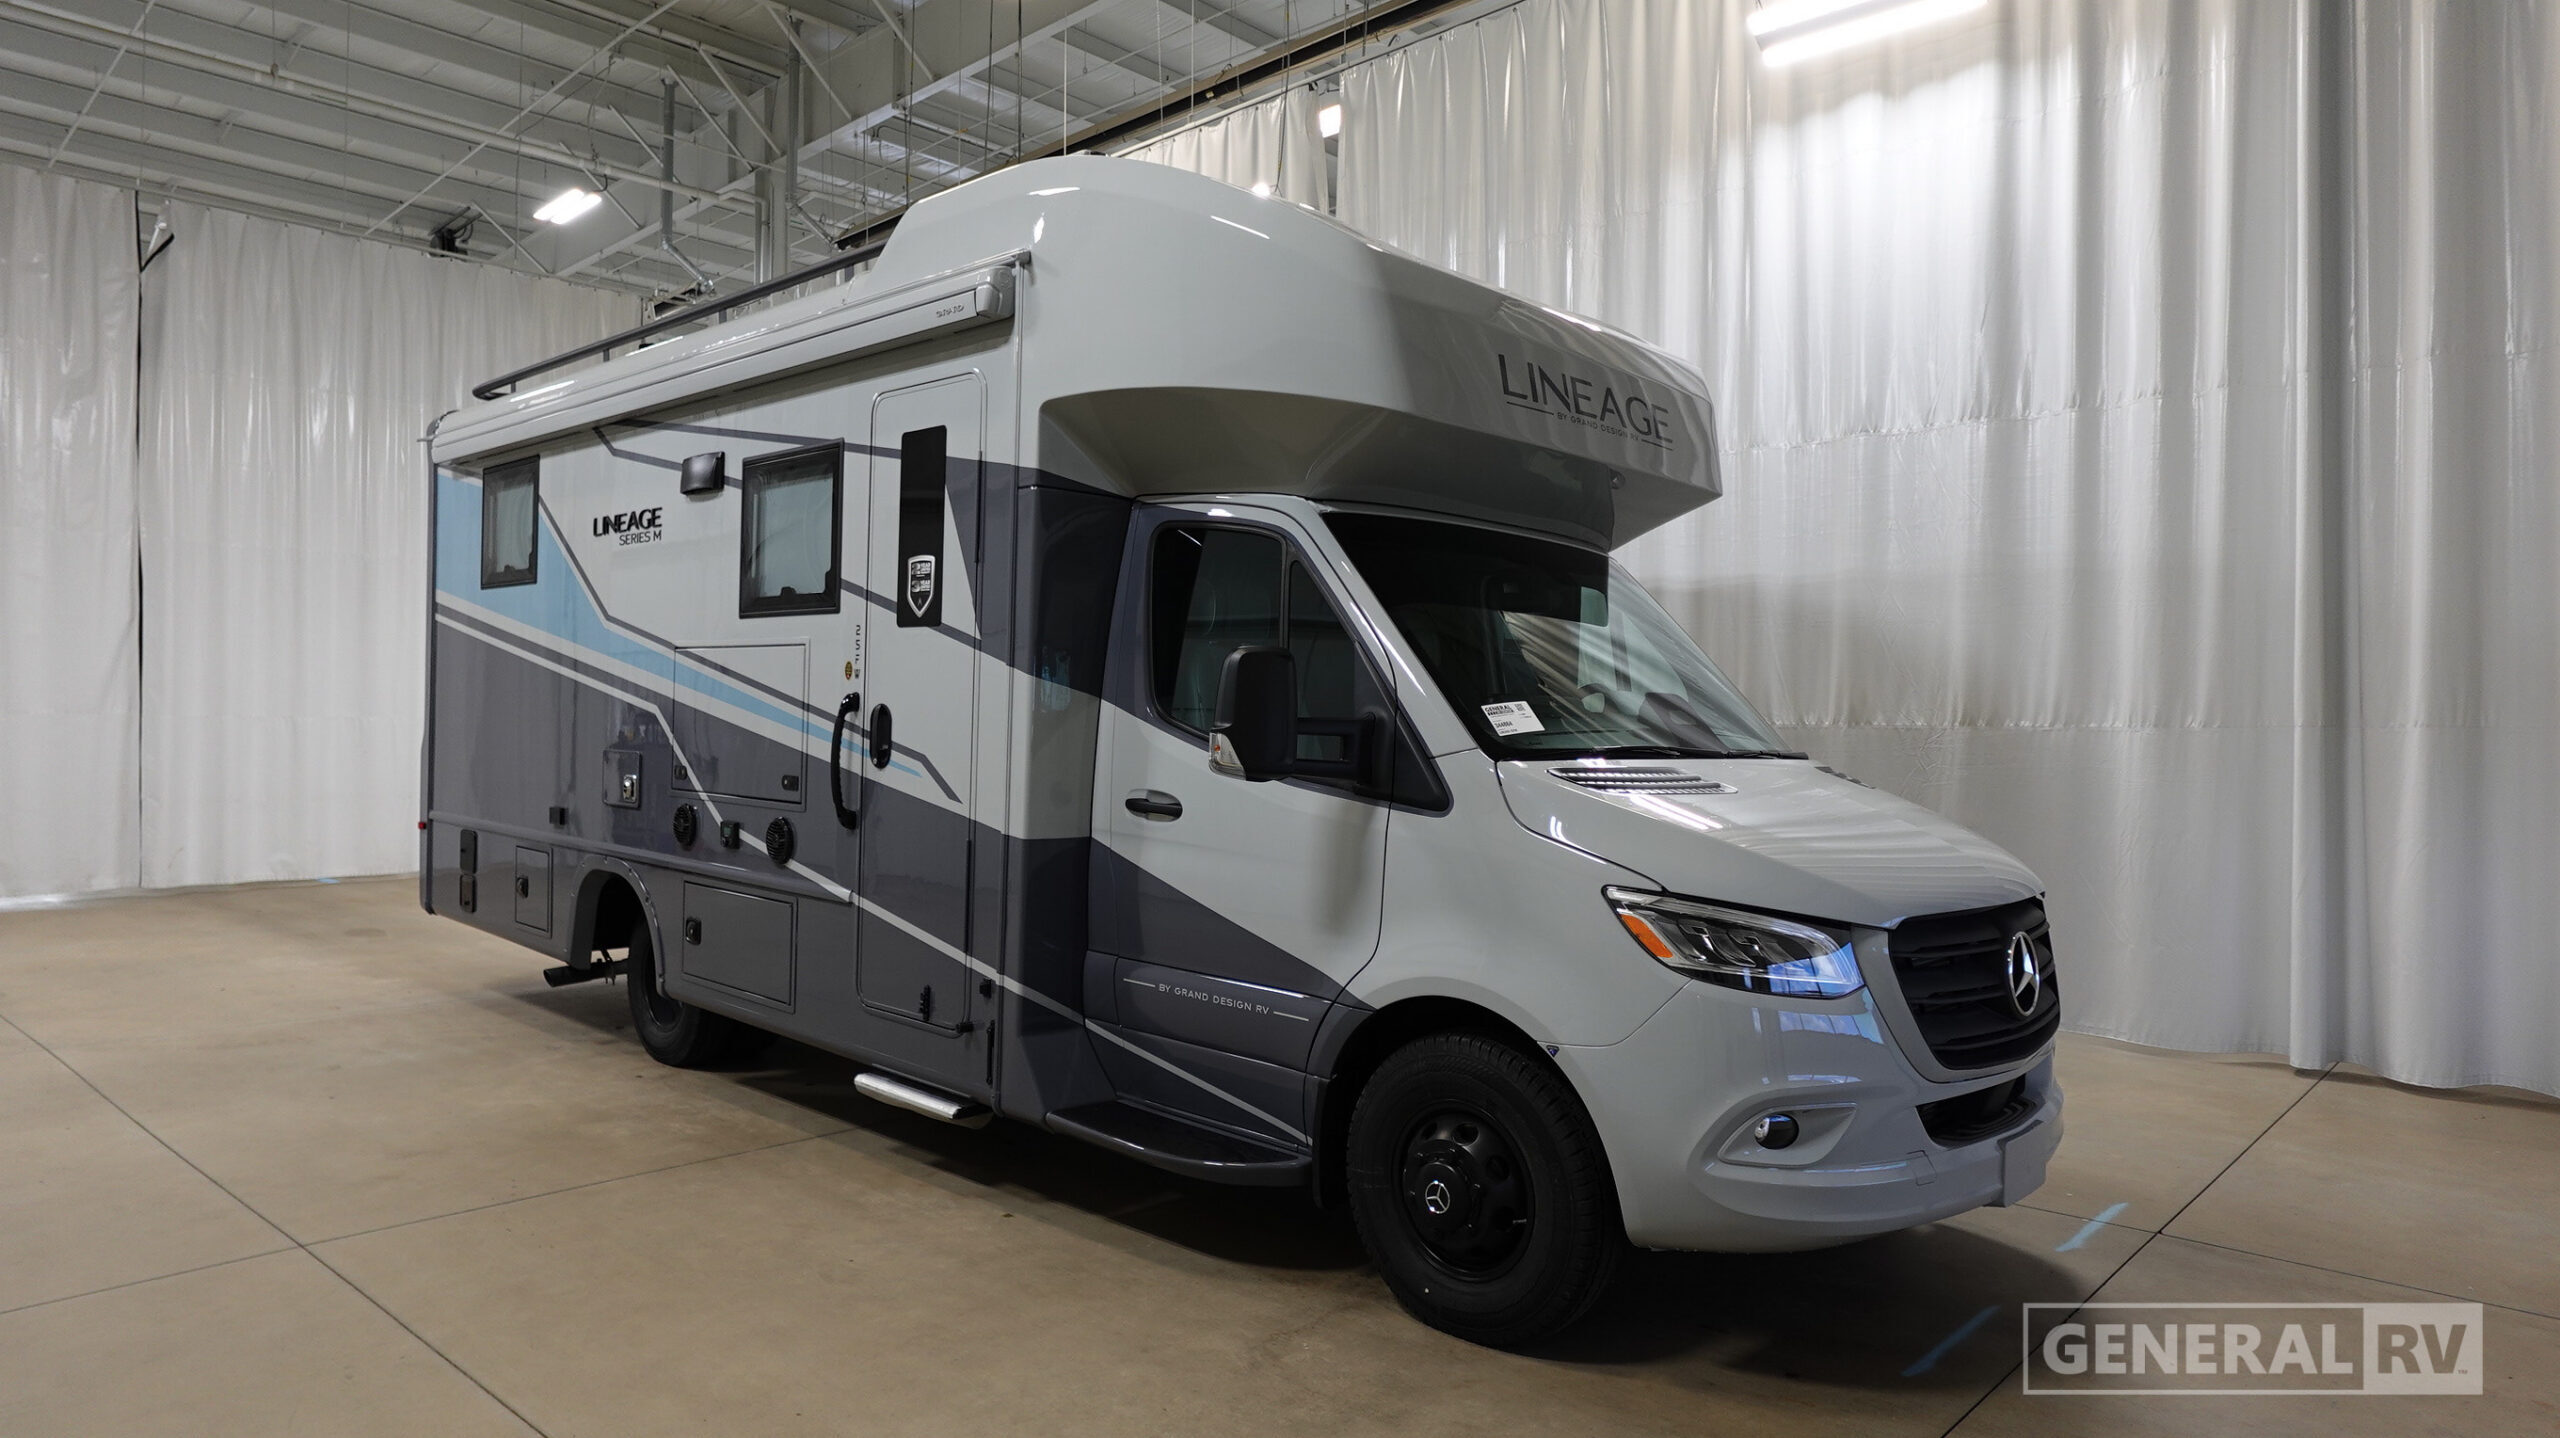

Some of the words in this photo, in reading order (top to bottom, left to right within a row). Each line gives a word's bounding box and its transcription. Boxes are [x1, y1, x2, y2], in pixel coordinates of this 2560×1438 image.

[1498, 354, 1673, 443] LINEAGE
[1557, 411, 1567, 421] BY
[1570, 416, 1599, 430] GRAND
[1601, 424, 1628, 438] DESIGN
[593, 507, 663, 538] LINEAGE
[619, 531, 651, 546] SERIES
[653, 529, 662, 541] M
[1158, 983, 1172, 993] BY
[1174, 987, 1209, 1001] GRAND
[1212, 995, 1252, 1011] DESIGN
[1255, 1004, 1270, 1015] RV
